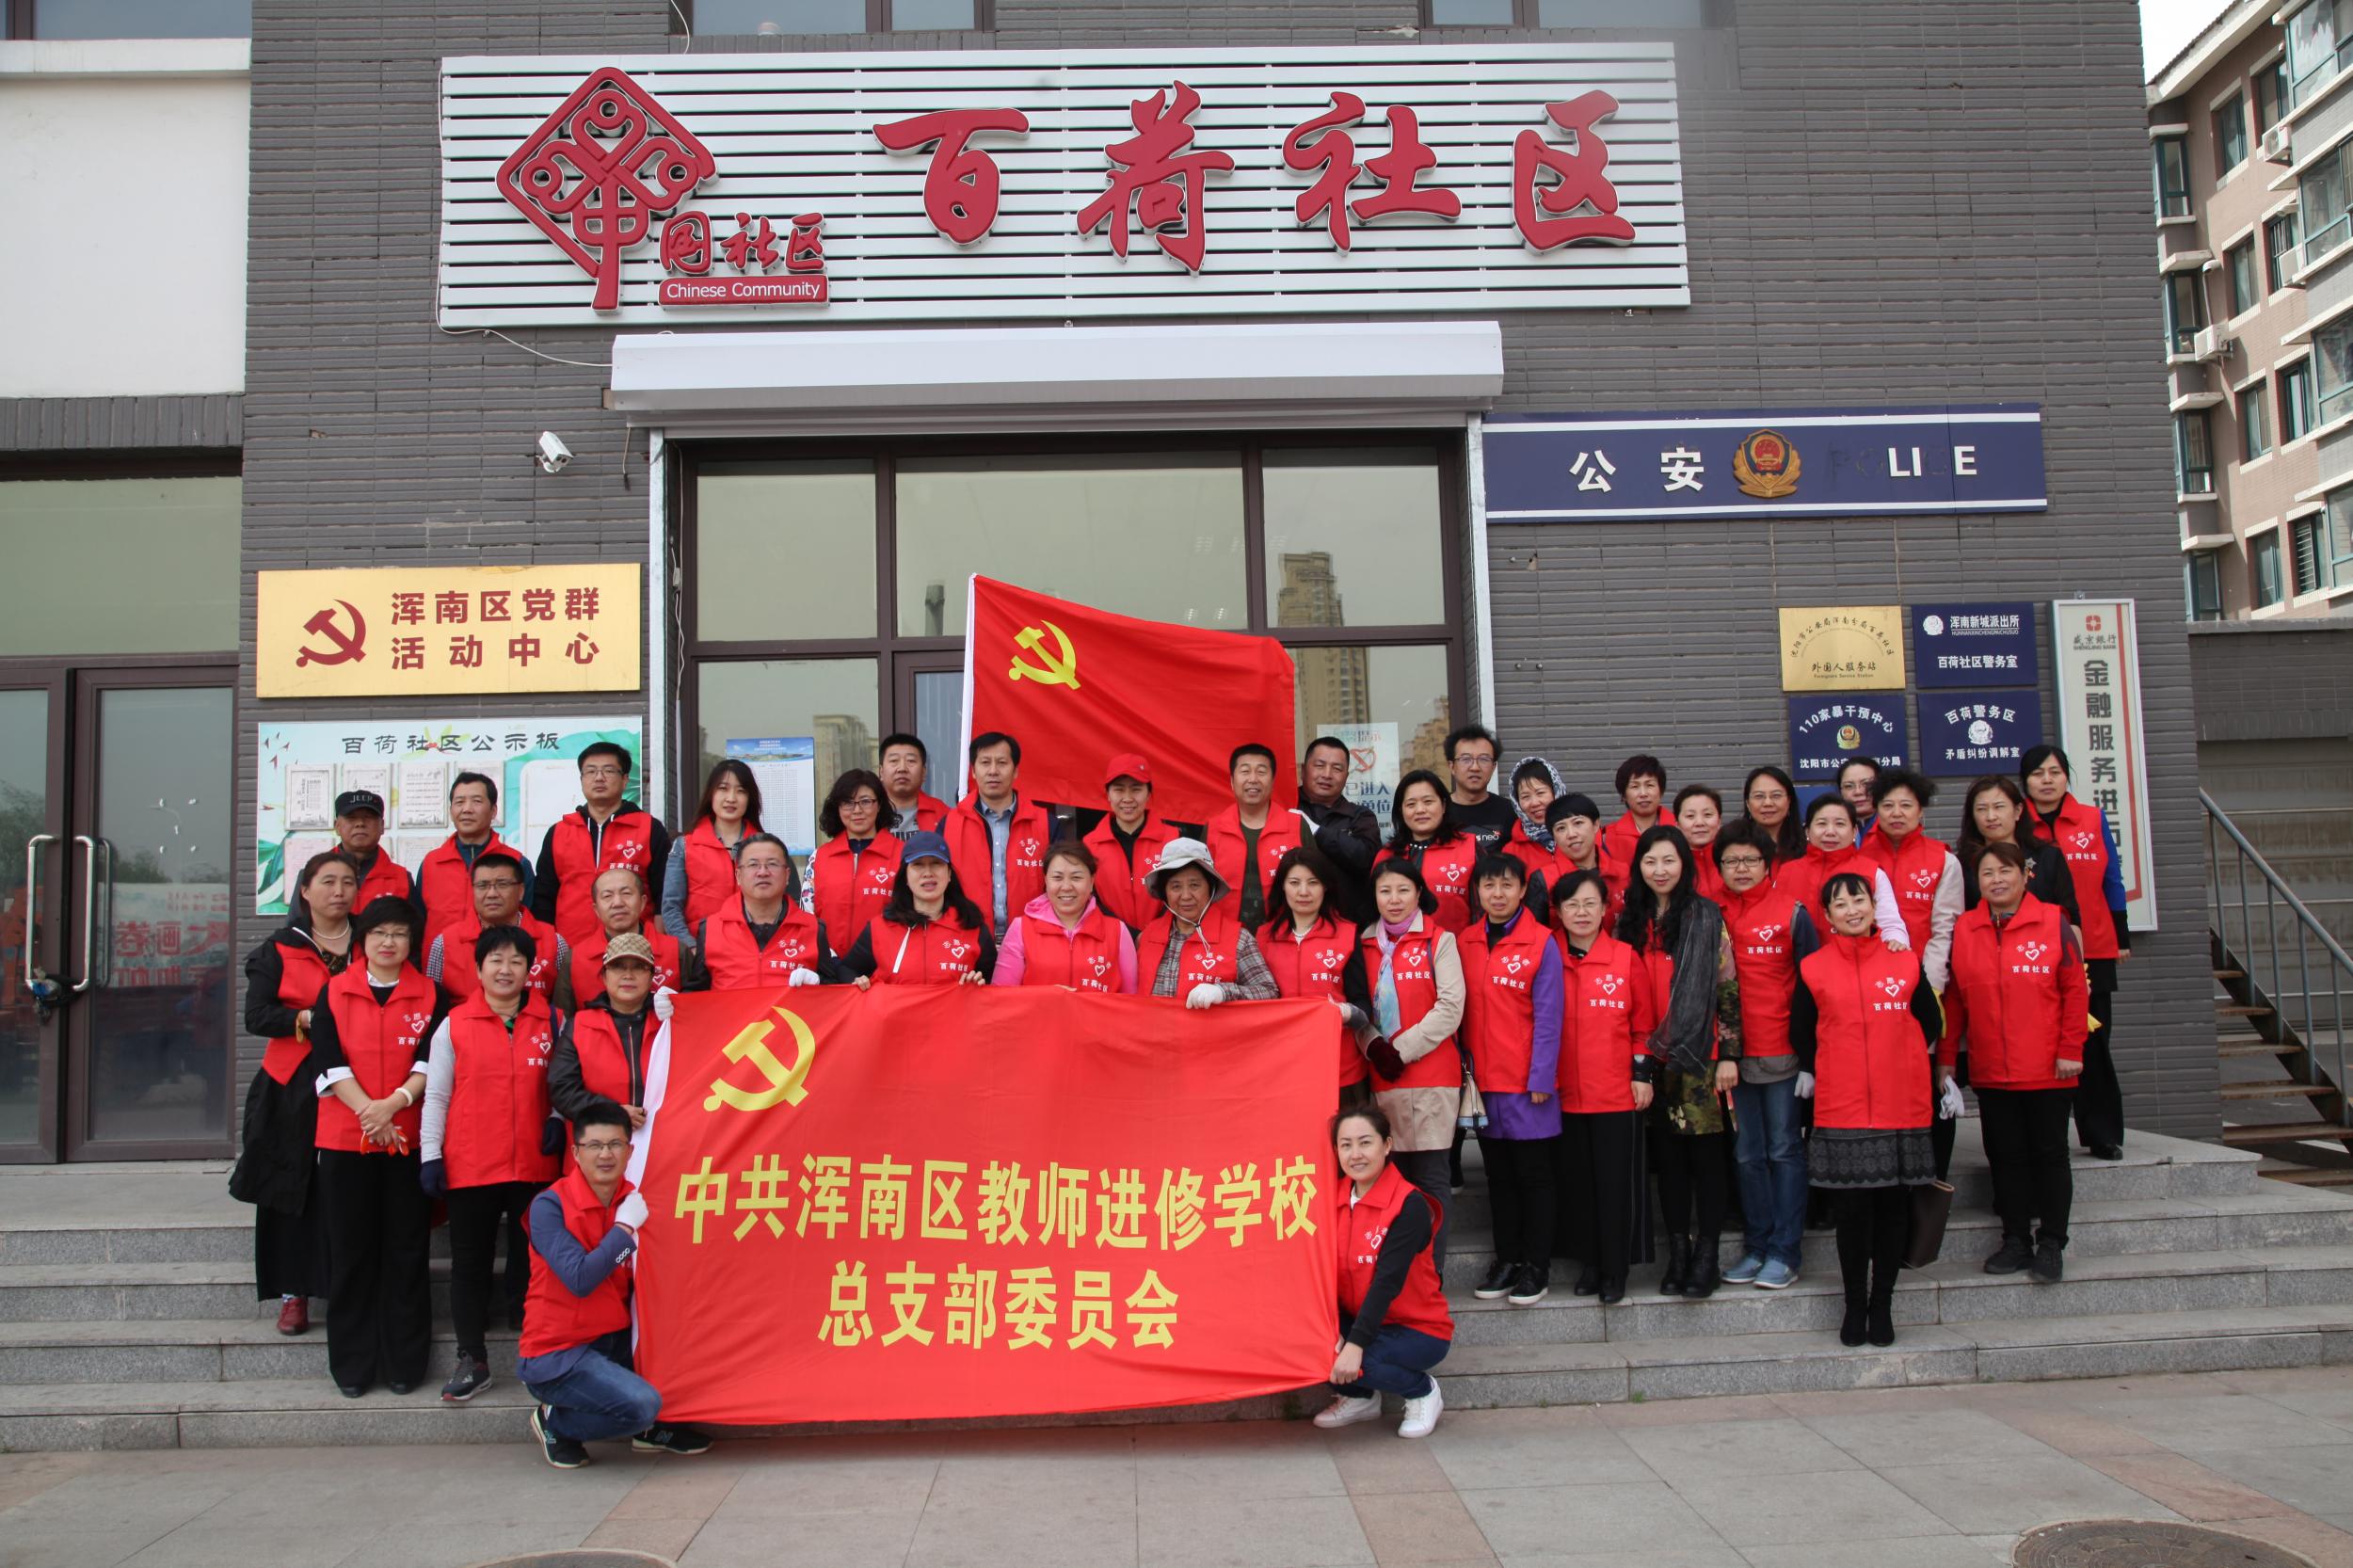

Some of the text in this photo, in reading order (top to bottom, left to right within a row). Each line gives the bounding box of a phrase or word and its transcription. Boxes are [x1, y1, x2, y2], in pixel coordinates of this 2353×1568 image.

[872, 80, 1637, 276] 百荷社区
[666, 282, 821, 299] Chinese Community
[392, 587, 600, 625] 浑南区党群
[1950, 615, 2020, 628] 浑南新城派出所
[392, 632, 600, 670] 活动中心
[1937, 655, 2018, 669] 百荷社区警务室
[1799, 705, 1894, 734] 110家暴干预中心
[1945, 704, 2016, 725] 百荷警务区
[342, 732, 561, 755] 百荷社区公示板
[1945, 746, 2020, 760] 矛盾纠纷调解室
[2084, 660, 2122, 880] 金融服务进
[675, 1154, 1319, 1250] 中共浑南区教师进修学校
[818, 1259, 1180, 1350] 总支部委员会
